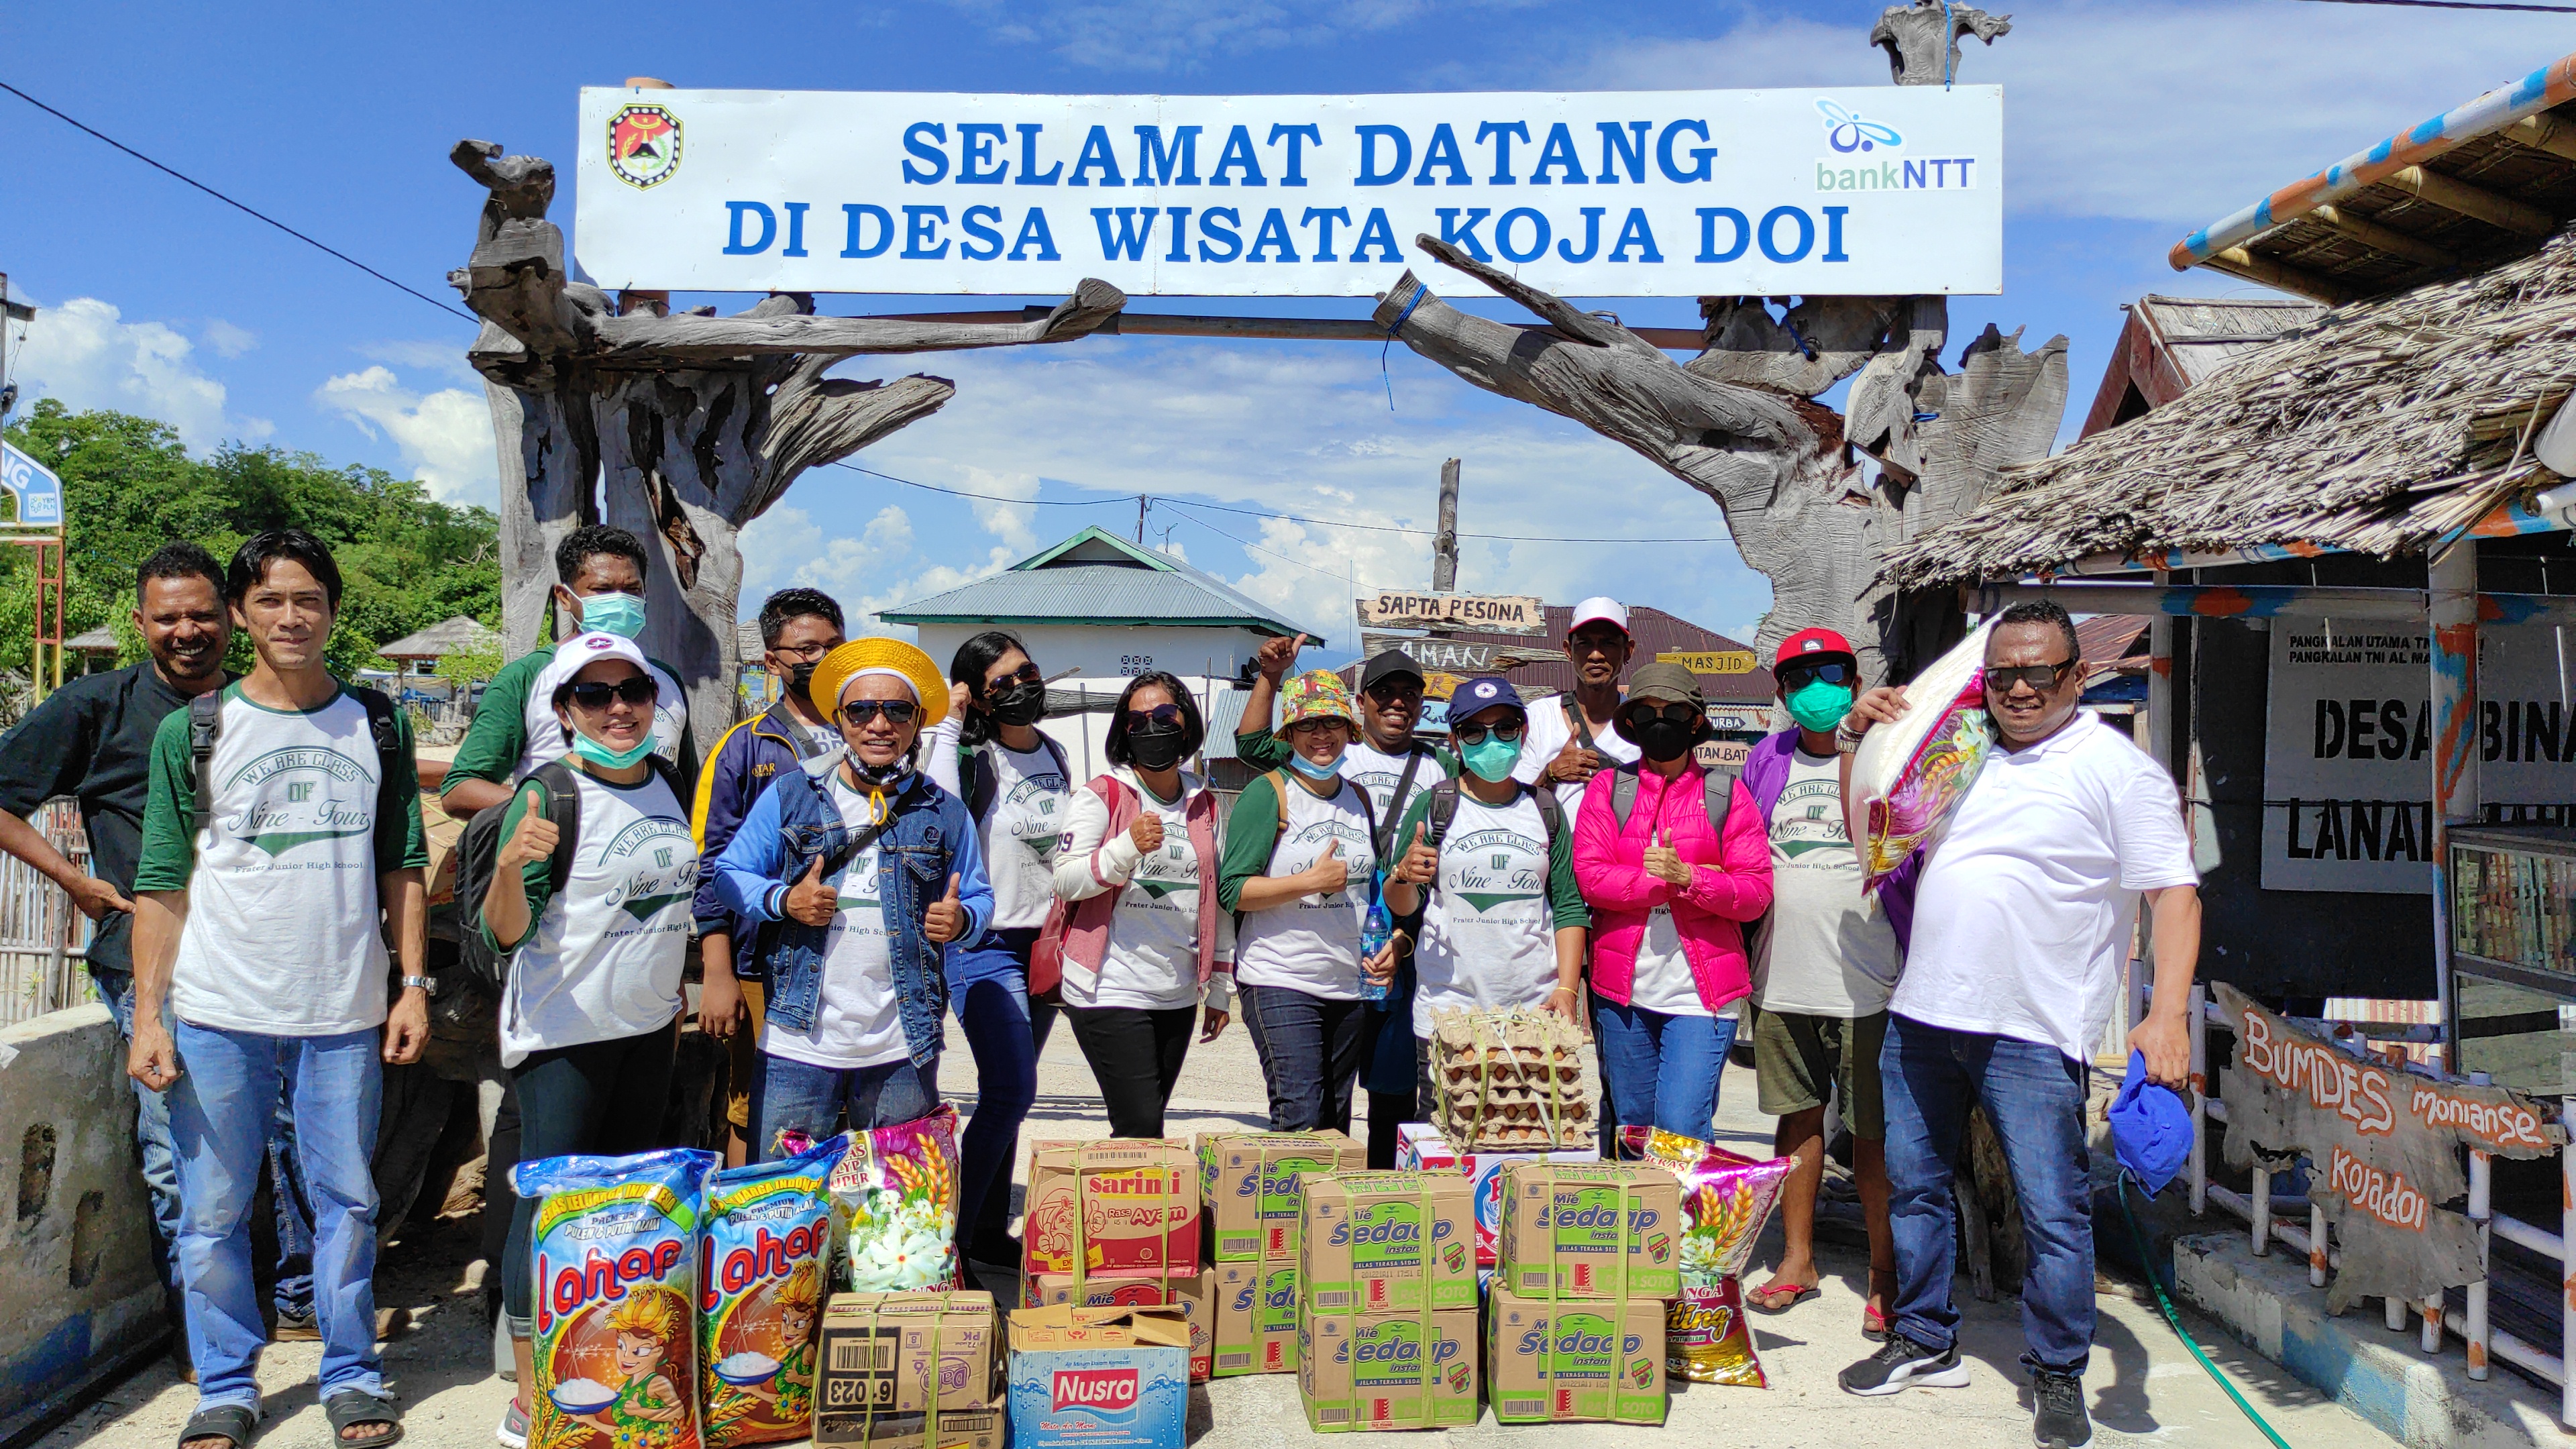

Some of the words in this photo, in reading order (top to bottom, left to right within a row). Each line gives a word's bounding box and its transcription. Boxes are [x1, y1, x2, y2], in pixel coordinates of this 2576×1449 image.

[902, 122, 1322, 186] SELAMAT
[1354, 119, 1717, 186] DATANG
[1817, 158, 1974, 191] bankNTT
[723, 201, 810, 257] DI
[841, 204, 1061, 261] DESA
[1090, 207, 1403, 263] WISATA
[1436, 207, 1664, 263] KOJA
[1695, 206, 1848, 263] DOI
[1378, 595, 1440, 616] SAPTA
[1450, 598, 1525, 623] PESONA
[2290, 635, 2363, 648] PANGKALAN
[2366, 636, 2410, 649] UTAMA
[1399, 640, 1489, 667] AMAN
[2289, 651, 2361, 663] PANGKALAN
[2365, 651, 2384, 663] TNI
[2389, 652, 2407, 663] AL
[1682, 657, 1741, 671] MASJID
[242, 762, 271, 785] WE
[275, 753, 307, 769] ARE
[313, 753, 360, 782] CLASS
[288, 780, 317, 804] OF
[1777, 789, 1796, 805] WE
[1800, 784, 1824, 795] ARE
[228, 801, 289, 832] Nine
[313, 799, 370, 827] Four
[1039, 797, 1055, 816] OF
[1806, 804, 1828, 820] OF
[1011, 814, 1049, 837] Nine
[1769, 818, 1807, 840] Nine
[614, 836, 634, 857] WE
[633, 822, 657, 841] ARE
[1458, 837, 1477, 852] WE
[1480, 834, 1503, 844] ARE
[1507, 834, 1540, 856] CLASS
[653, 847, 674, 869] OF
[1169, 845, 1184, 861] OF
[1491, 854, 1511, 871] OF
[235, 865, 265, 873] Frater
[268, 862, 303, 871] Junior
[307, 861, 331, 871] High
[849, 856, 873, 875] OF
[1130, 854, 1169, 876] Nine
[1449, 865, 1492, 890] Nine
[605, 870, 660, 906] Nine
[1150, 903, 1173, 912] Junior
[849, 925, 870, 935] High
[1501, 918, 1517, 926] High
[604, 929, 635, 938] Frater
[637, 926, 665, 936] Junior
[2245, 1012, 2393, 1131] BUMDES
[1089, 1171, 1181, 1194] sarimi
[751, 1197, 795, 1214] PREMIUM
[1554, 1193, 1580, 1205] Mie
[729, 1212, 757, 1226] PULEN
[767, 1206, 793, 1220] PUTIH
[1108, 1208, 1132, 1218] Rasa
[1130, 1206, 1187, 1227] Ayam
[1344, 1208, 1373, 1222] Mie
[564, 1223, 595, 1240] PULEN
[605, 1221, 633, 1238] PUTIH
[1640, 1275, 1674, 1287] SOTO
[1086, 1292, 1116, 1307] Mie
[1435, 1285, 1469, 1299] SOTO
[963, 1331, 981, 1341] PK
[1354, 1326, 1380, 1339] Mie
[1057, 1375, 1136, 1402] Nusra
[1439, 1405, 1472, 1417] SOTO
[1622, 1402, 1656, 1414] SOTO
